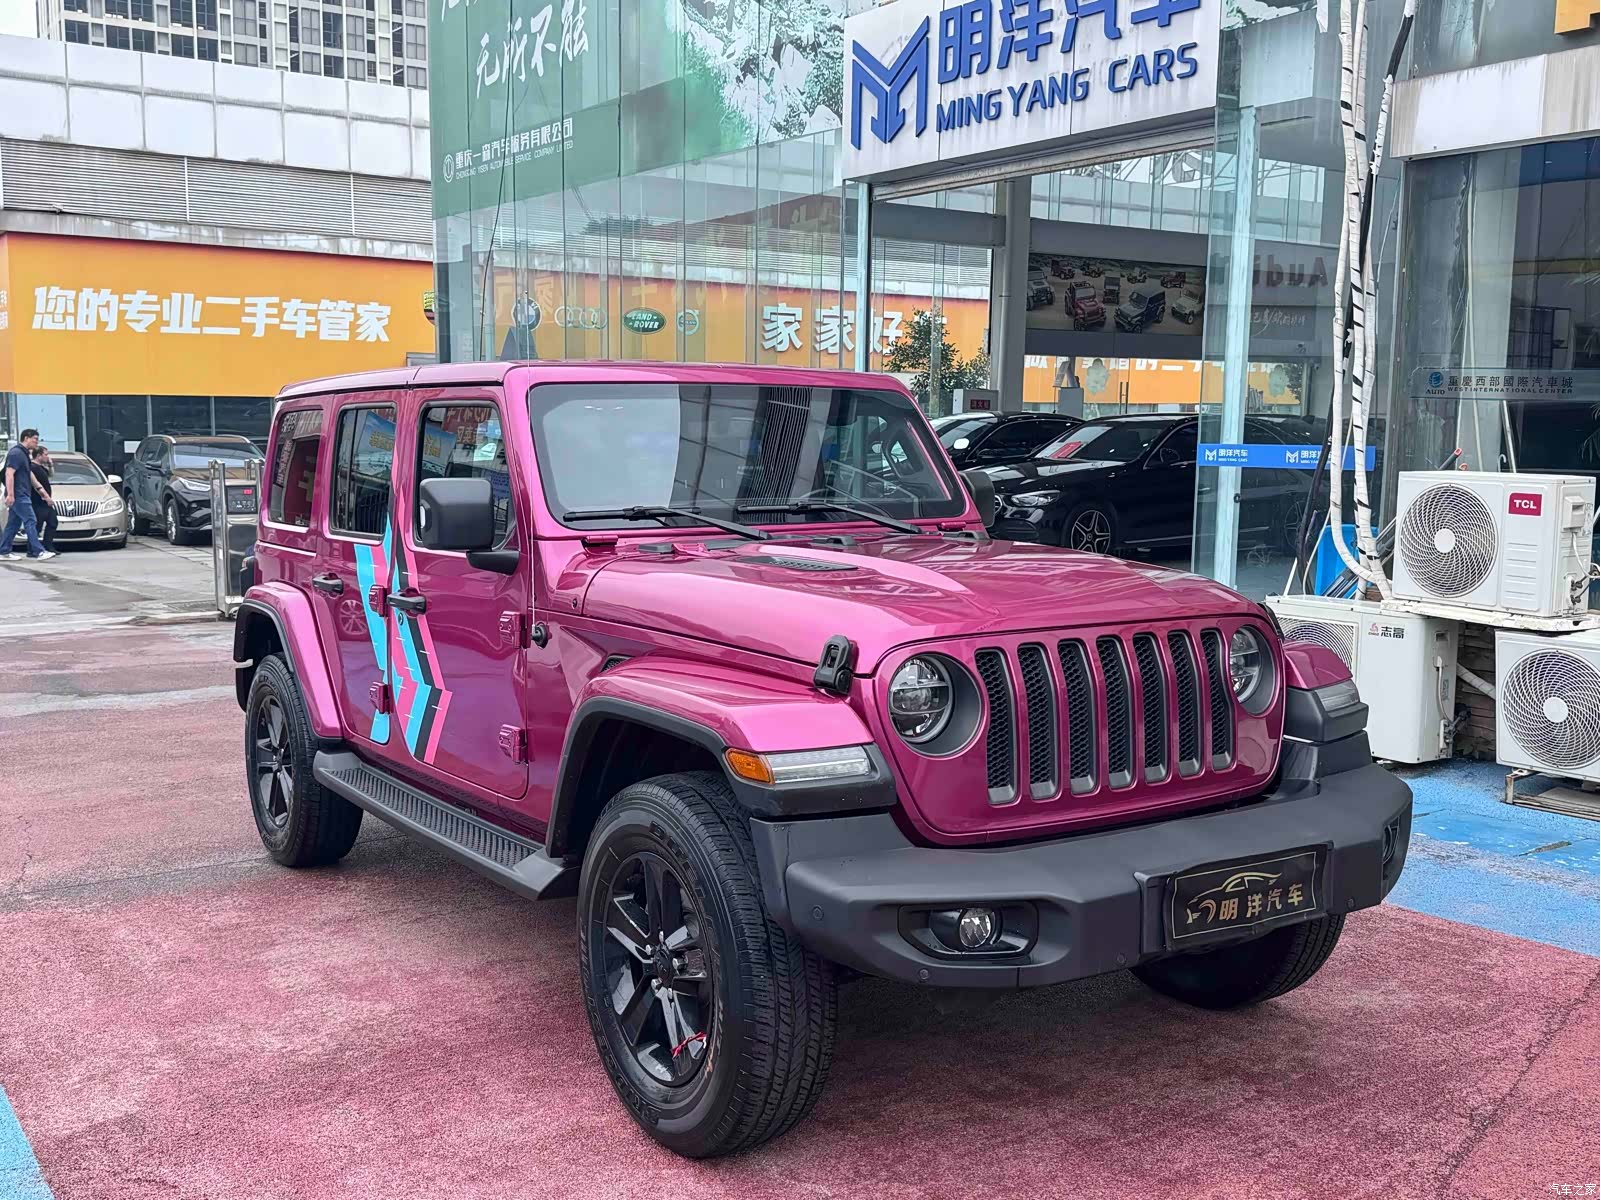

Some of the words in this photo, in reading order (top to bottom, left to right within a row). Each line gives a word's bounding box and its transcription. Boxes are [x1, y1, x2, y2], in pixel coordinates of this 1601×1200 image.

[936, 88, 1002, 133] MING
[1007, 67, 1089, 117] YANG
[1108, 42, 1197, 93] CARS
[31, 286, 392, 342] 您的专业二手车管家
[631, 313, 652, 321] LAND
[633, 320, 659, 329] ROVER
[1447, 375, 1573, 389] 重慶西部國際汽車城
[1513, 499, 1537, 509] TCL
[1380, 626, 1405, 639] 志高
[1218, 882, 1304, 922] 明洋汽车
